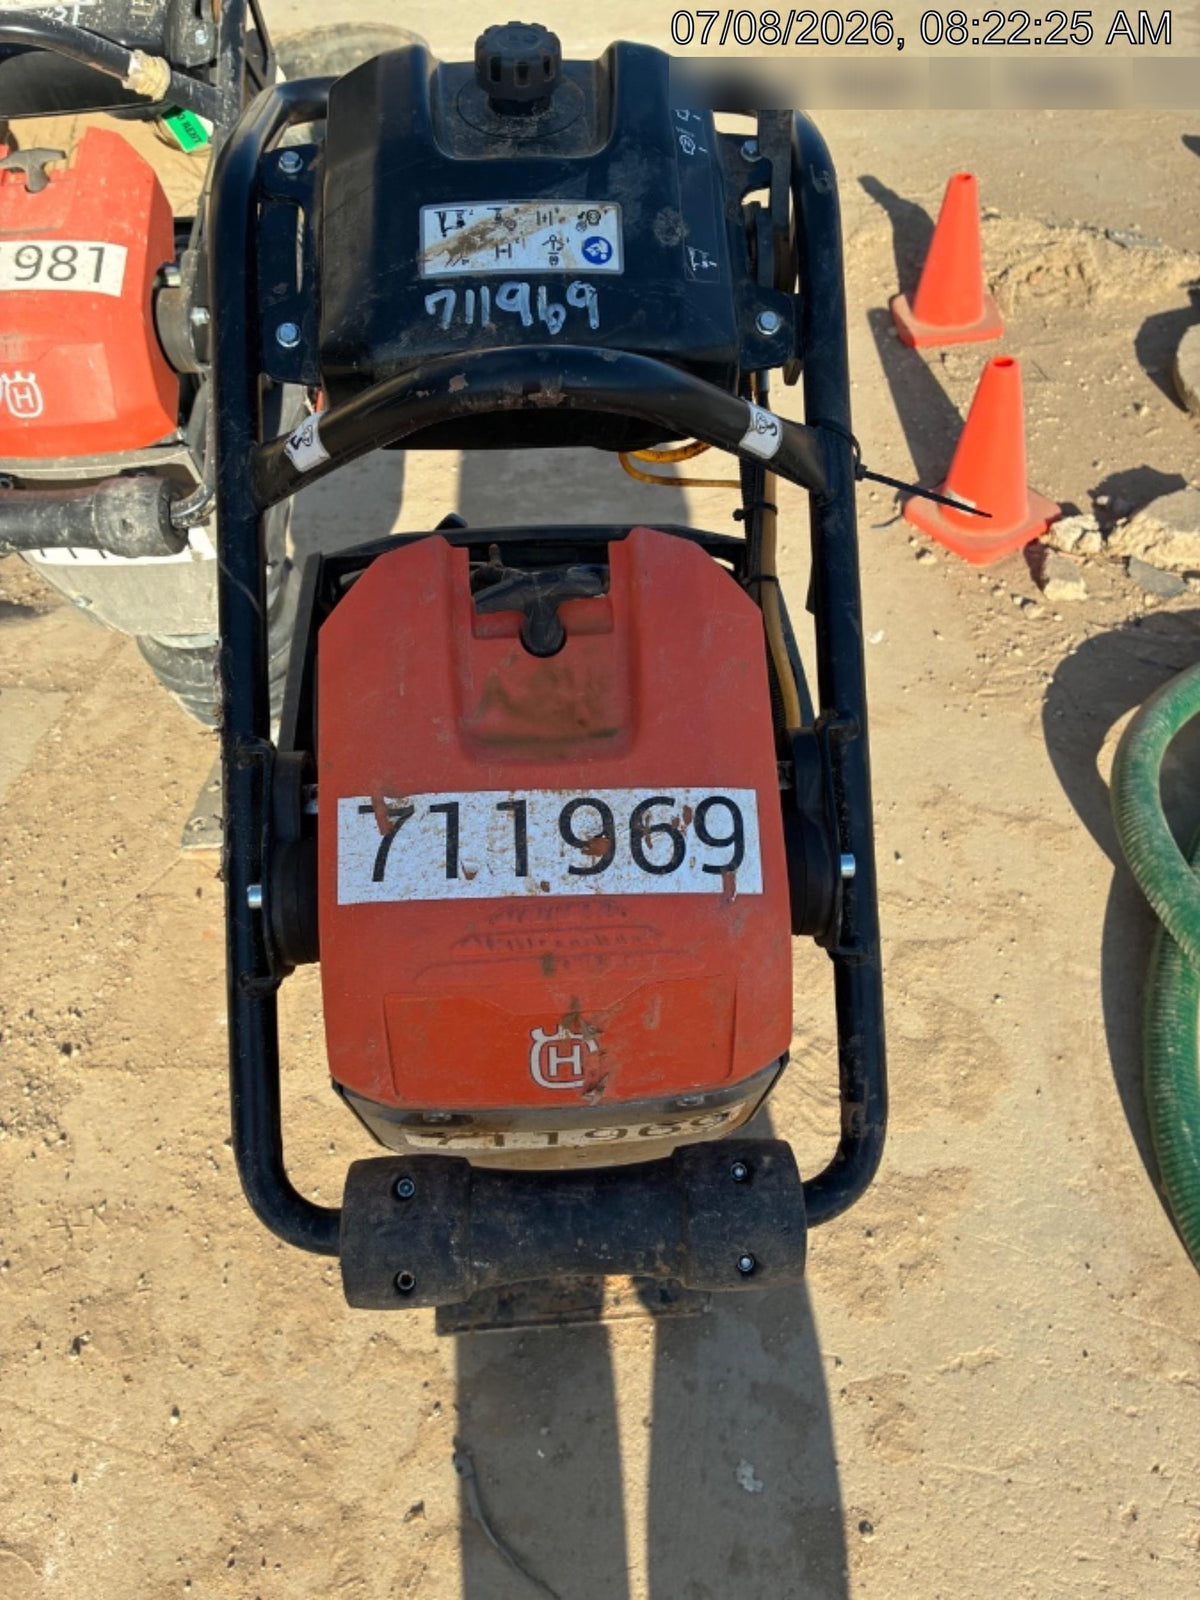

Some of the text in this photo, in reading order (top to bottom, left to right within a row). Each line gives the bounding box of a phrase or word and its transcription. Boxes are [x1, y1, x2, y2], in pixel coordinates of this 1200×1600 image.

[0, 245, 106, 283] 981
[424, 280, 600, 335] 711969
[358, 796, 745, 883] 711969
